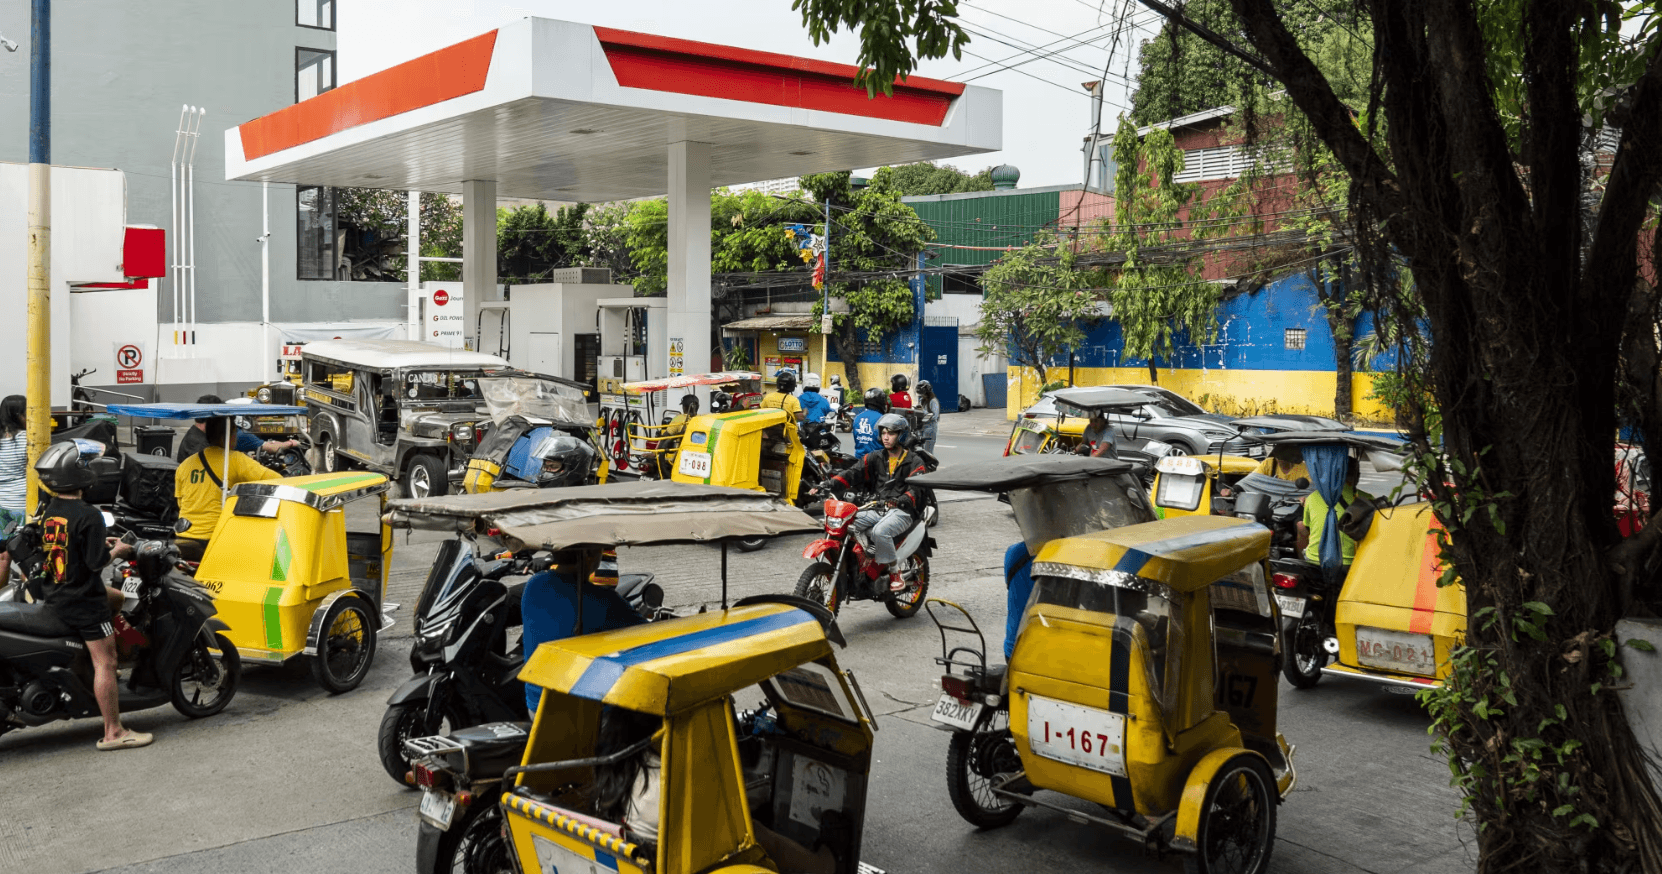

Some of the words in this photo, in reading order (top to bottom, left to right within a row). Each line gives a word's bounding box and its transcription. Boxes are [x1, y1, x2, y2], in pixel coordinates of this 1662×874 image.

[684, 458, 707, 471] T-098
[190, 469, 206, 484] 61
[935, 700, 978, 723] 382XKY
